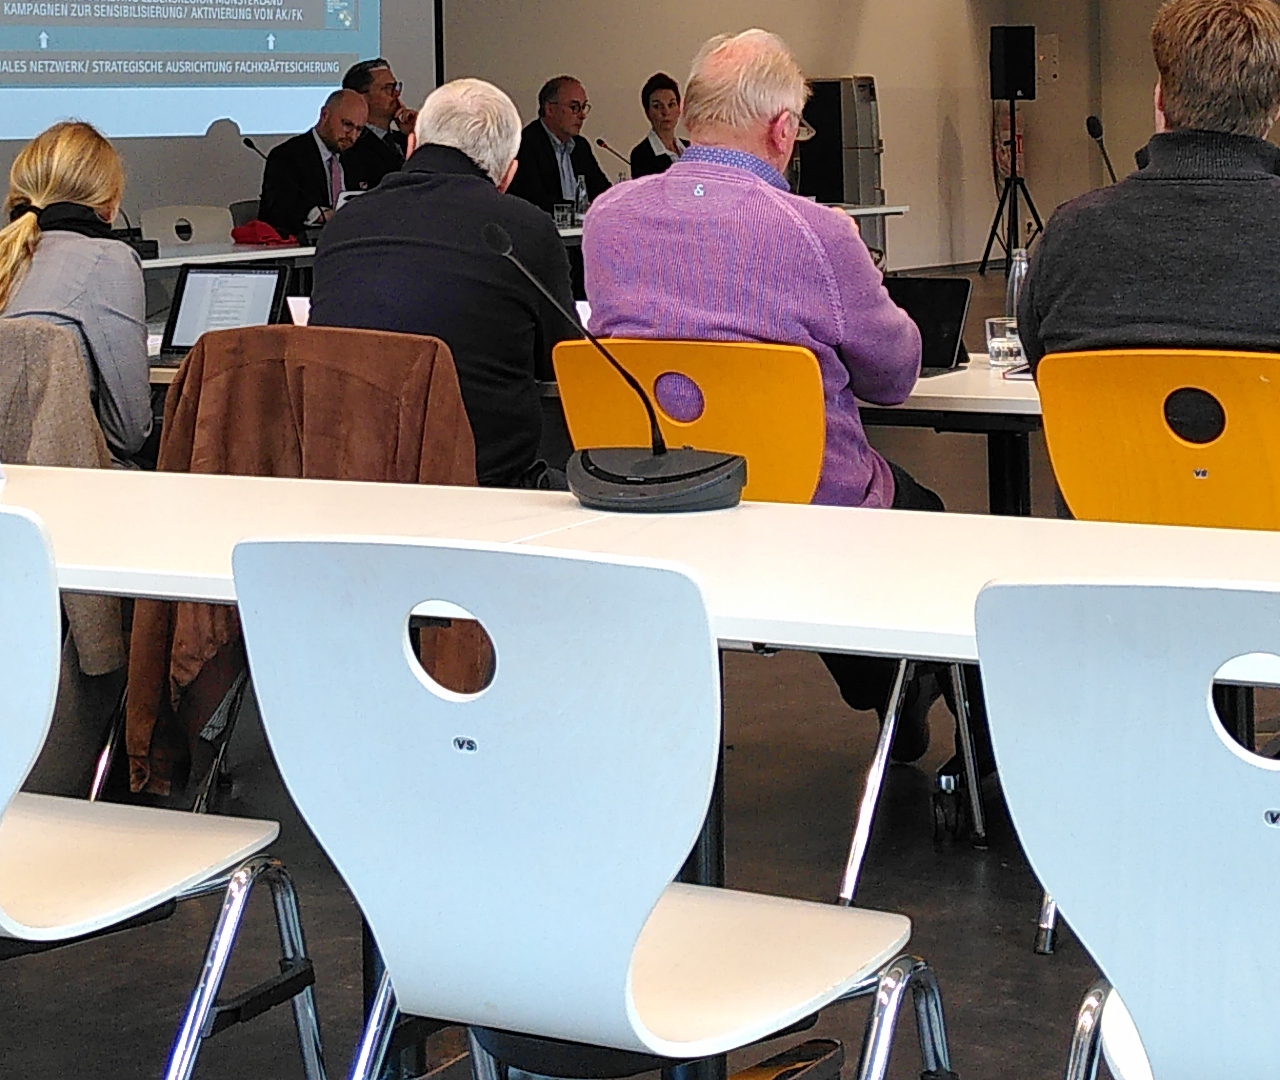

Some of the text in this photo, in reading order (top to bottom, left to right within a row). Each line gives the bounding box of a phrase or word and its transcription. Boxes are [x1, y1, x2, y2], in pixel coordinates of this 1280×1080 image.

[3, 2, 68, 16] KAMPAGNEN
[71, 5, 92, 17] ZUR
[93, 5, 188, 19] SENSIBILISIERUNG/
[190, 7, 252, 20] AKTIVIERUNG
[254, 8, 275, 20] VON
[29, 60, 89, 73] NETZWERK/
[92, 60, 163, 74] STRATEGISCHE
[167, 61, 232, 74] AUSRICHTUNG
[235, 59, 340, 74] FACHKRÄFTESICHERUNG
[456, 739, 476, 751] VS
